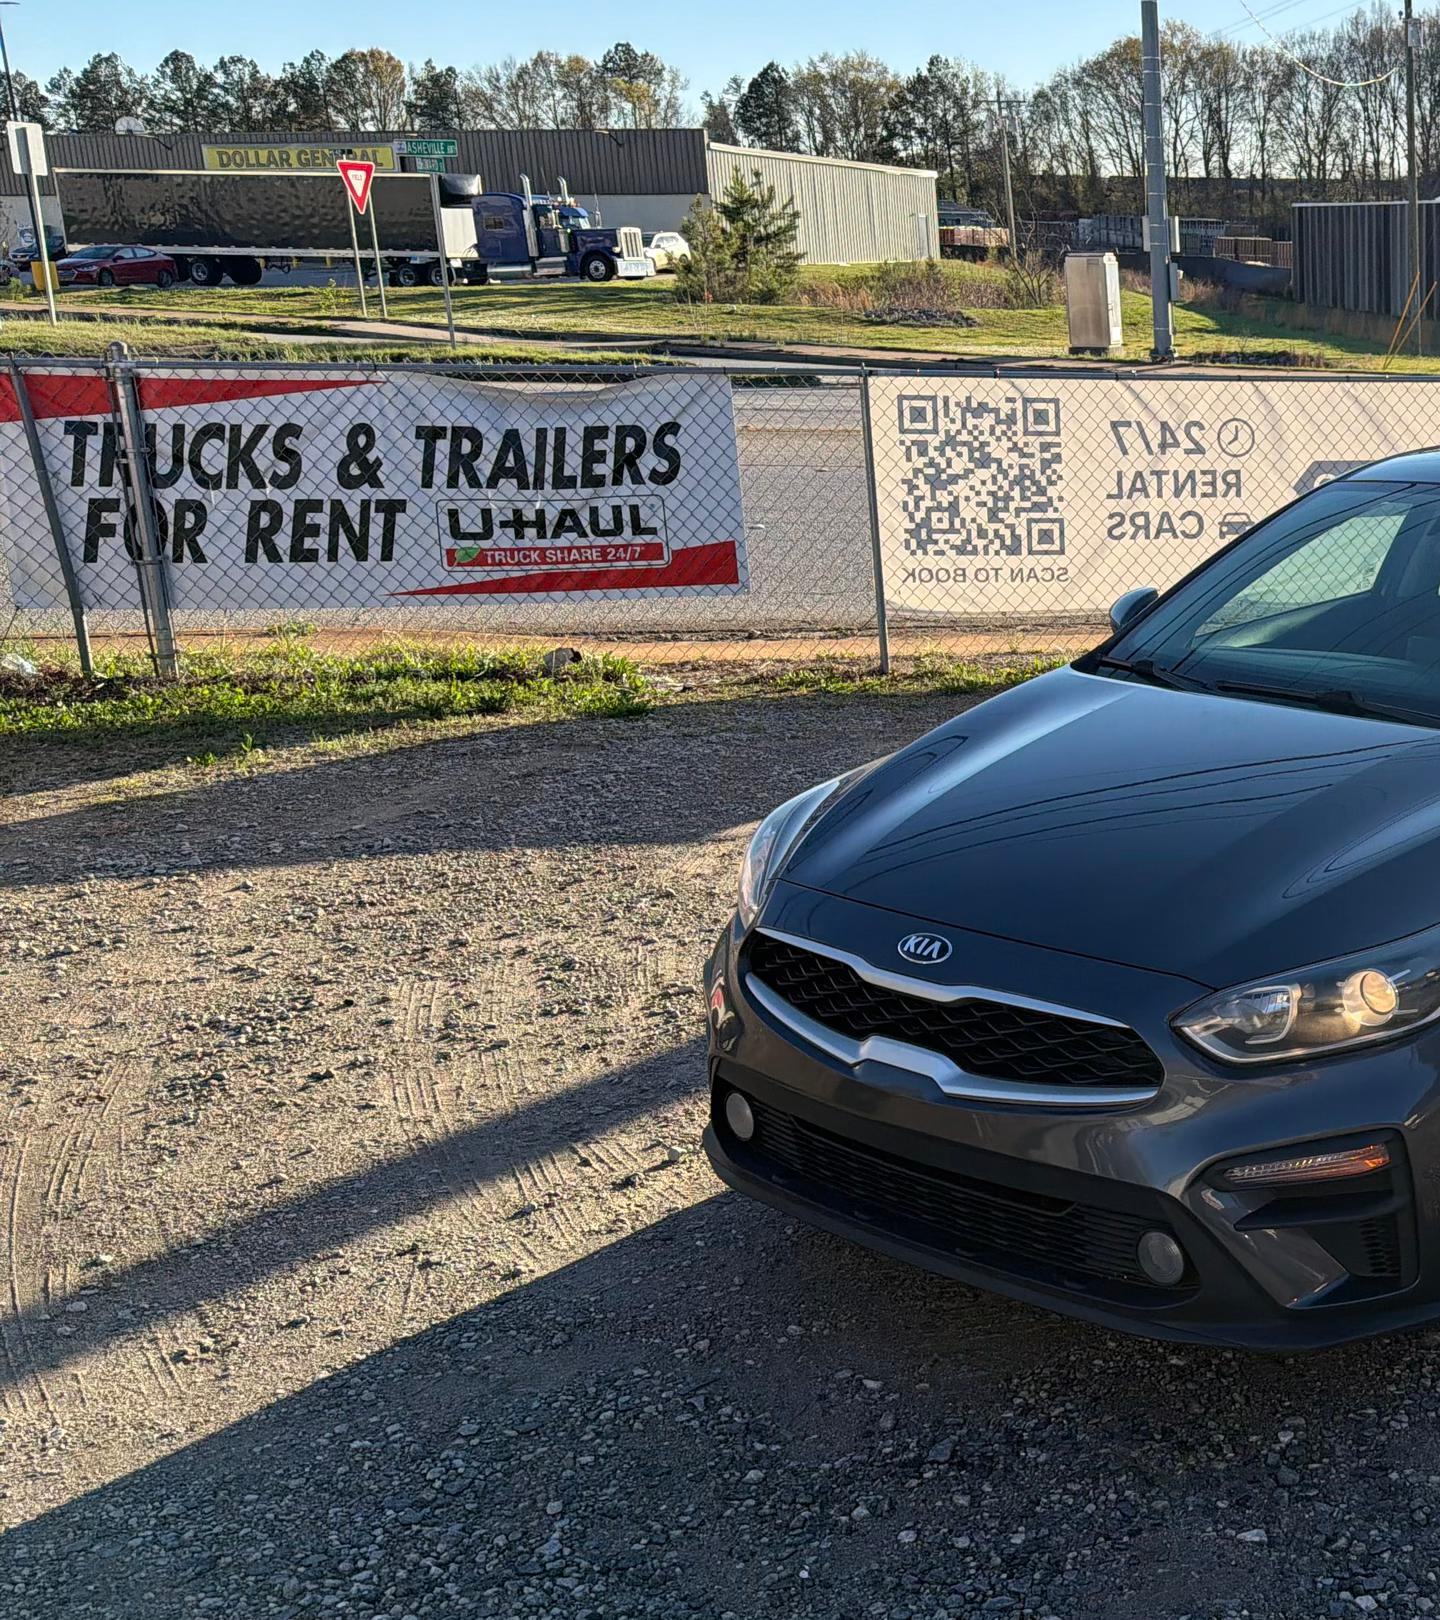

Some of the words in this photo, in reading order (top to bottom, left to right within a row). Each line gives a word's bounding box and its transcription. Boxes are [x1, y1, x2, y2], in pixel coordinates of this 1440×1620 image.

[407, 141, 445, 154] ASHEVILLE
[216, 150, 292, 168] DOLLAR
[63, 421, 304, 491] TRUCKS
[336, 422, 384, 490] &
[415, 421, 682, 491] TRAILERS
[83, 497, 209, 564] FOR
[244, 497, 407, 565] RENT
[483, 550, 543, 565] TRUCK
[545, 548, 603, 562] SHARE
[606, 545, 642, 562] 24/7
[903, 935, 942, 959] KIA
